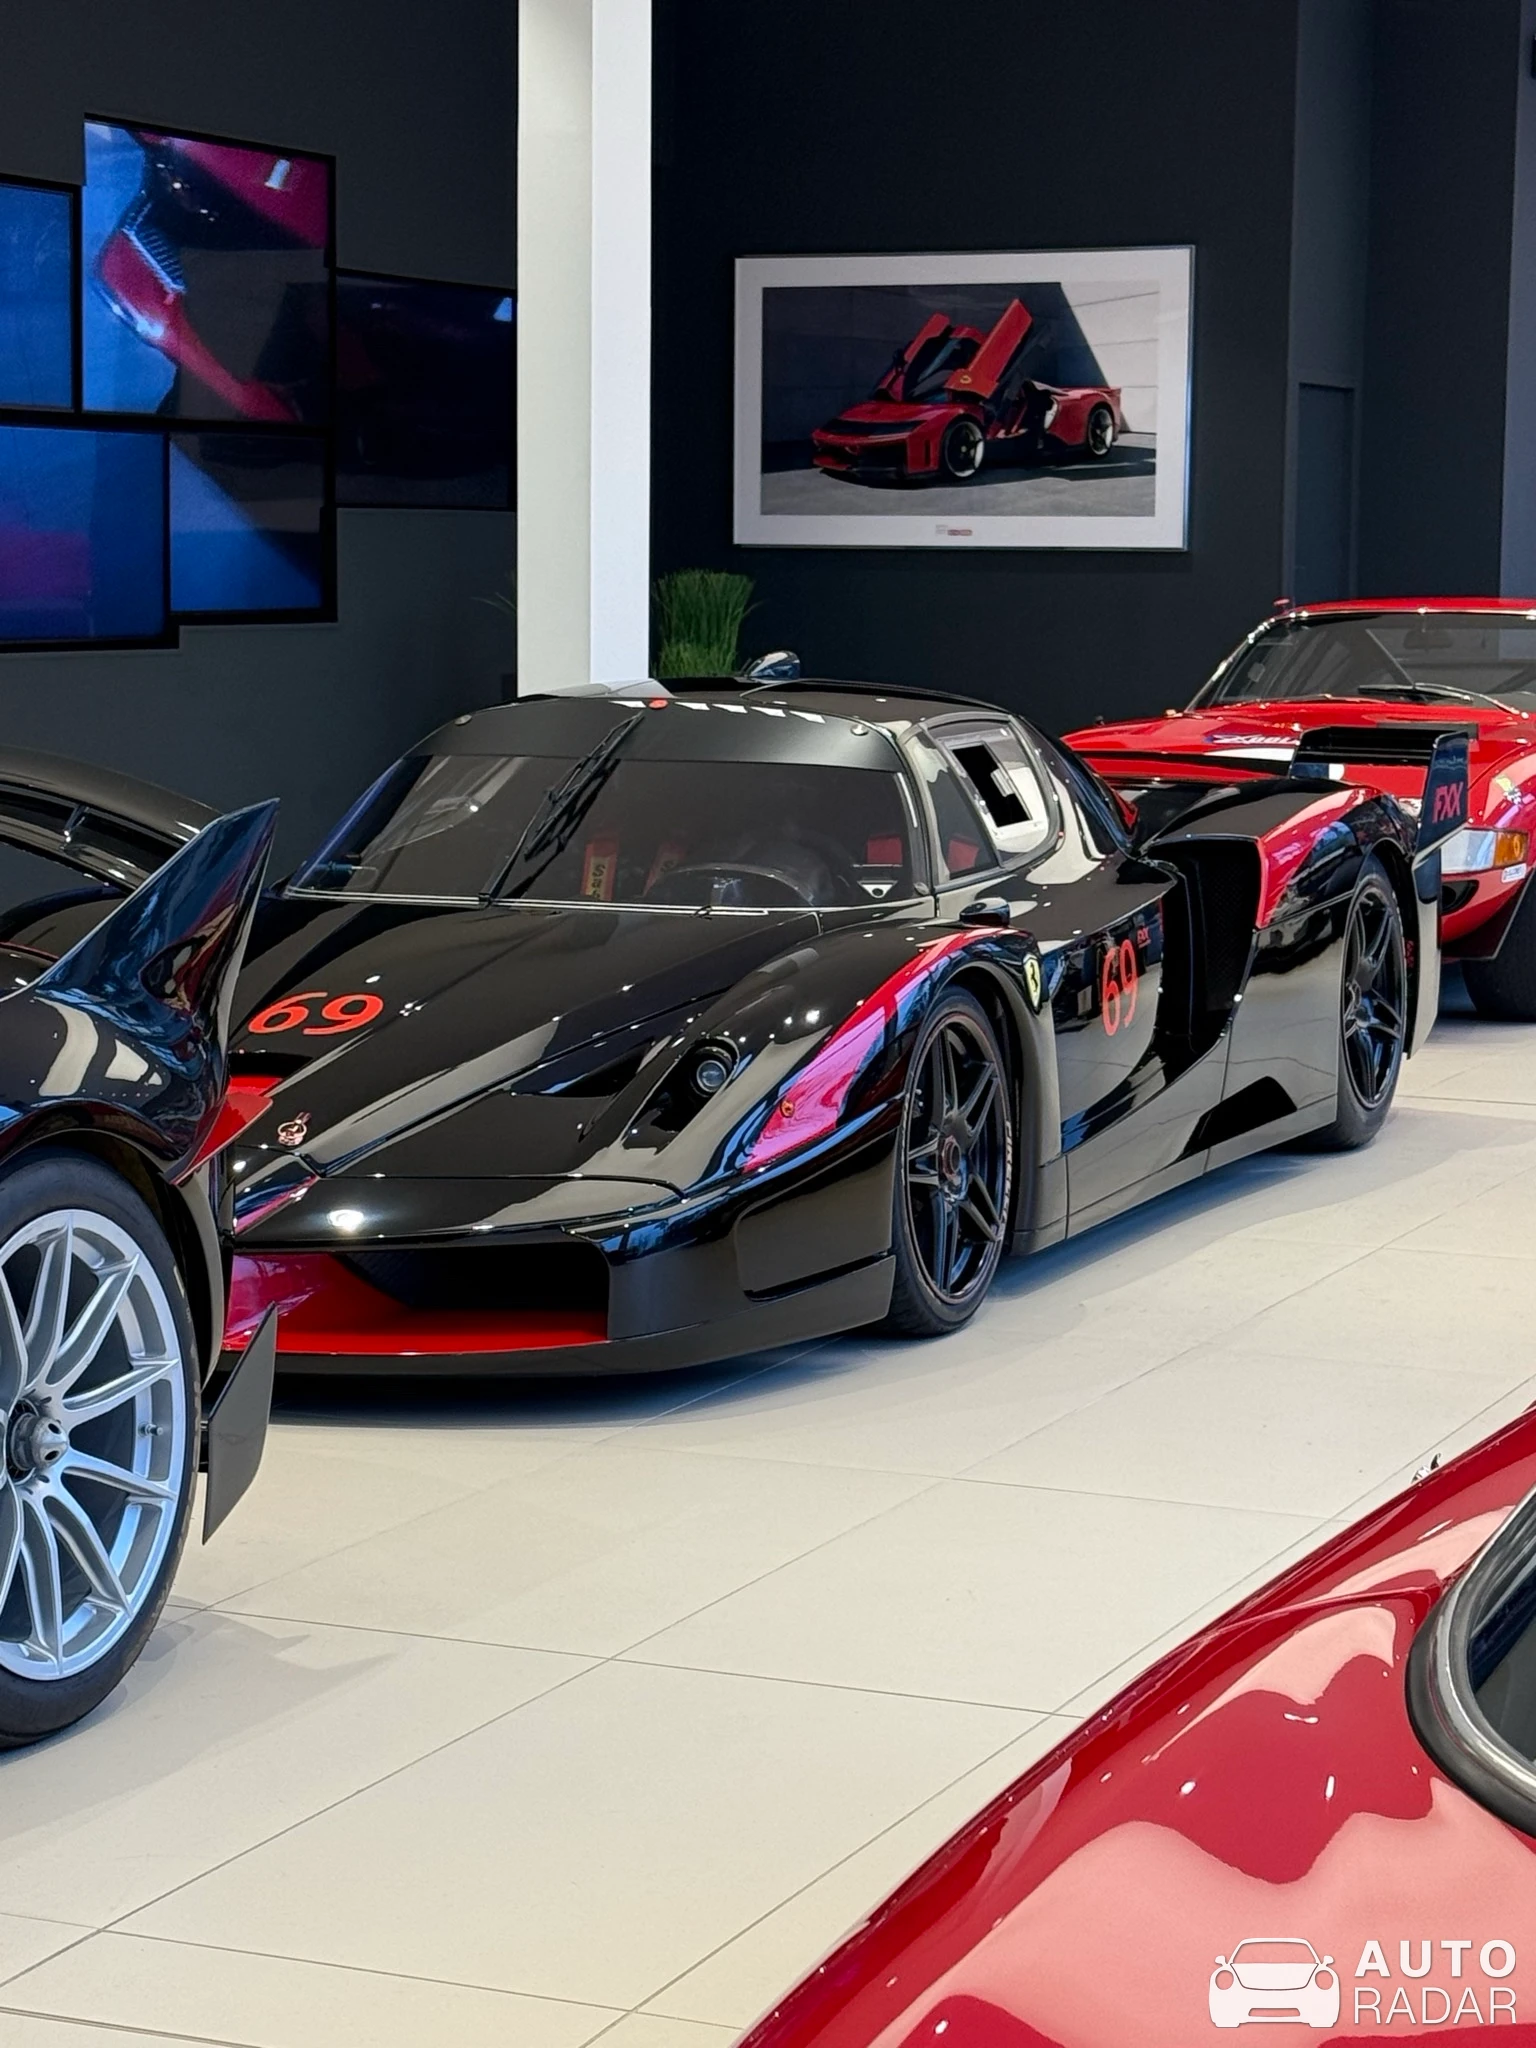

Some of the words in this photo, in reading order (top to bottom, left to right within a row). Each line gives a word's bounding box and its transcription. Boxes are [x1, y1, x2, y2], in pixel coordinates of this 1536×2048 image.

[1432, 781, 1464, 823] FXX
[1102, 939, 1138, 1036] 69
[248, 992, 384, 1035] 69
